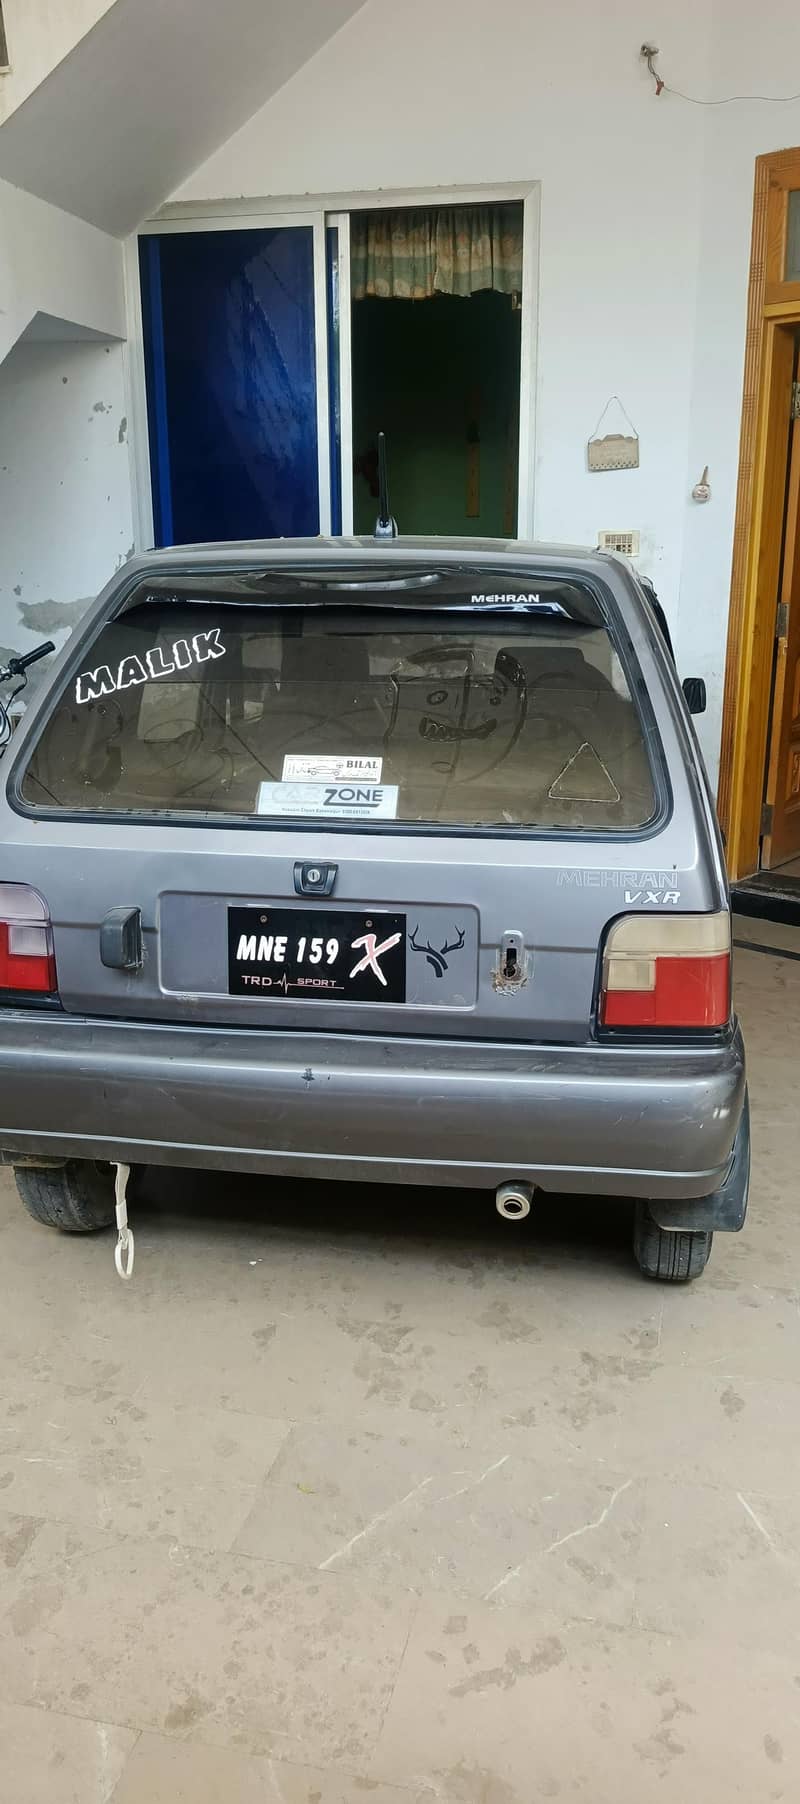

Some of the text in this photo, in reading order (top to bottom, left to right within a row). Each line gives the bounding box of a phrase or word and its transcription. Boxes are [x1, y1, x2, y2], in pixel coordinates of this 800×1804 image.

[471, 593, 540, 603] MEHRAN
[76, 628, 226, 704] MALIK
[346, 760, 379, 769] BILAL
[323, 788, 384, 808] ZONE
[557, 870, 678, 889] MEHRAN
[624, 890, 681, 904] VXR
[236, 934, 288, 962] MNE
[296, 936, 340, 965] 159
[241, 975, 338, 987] TRD SPORT
